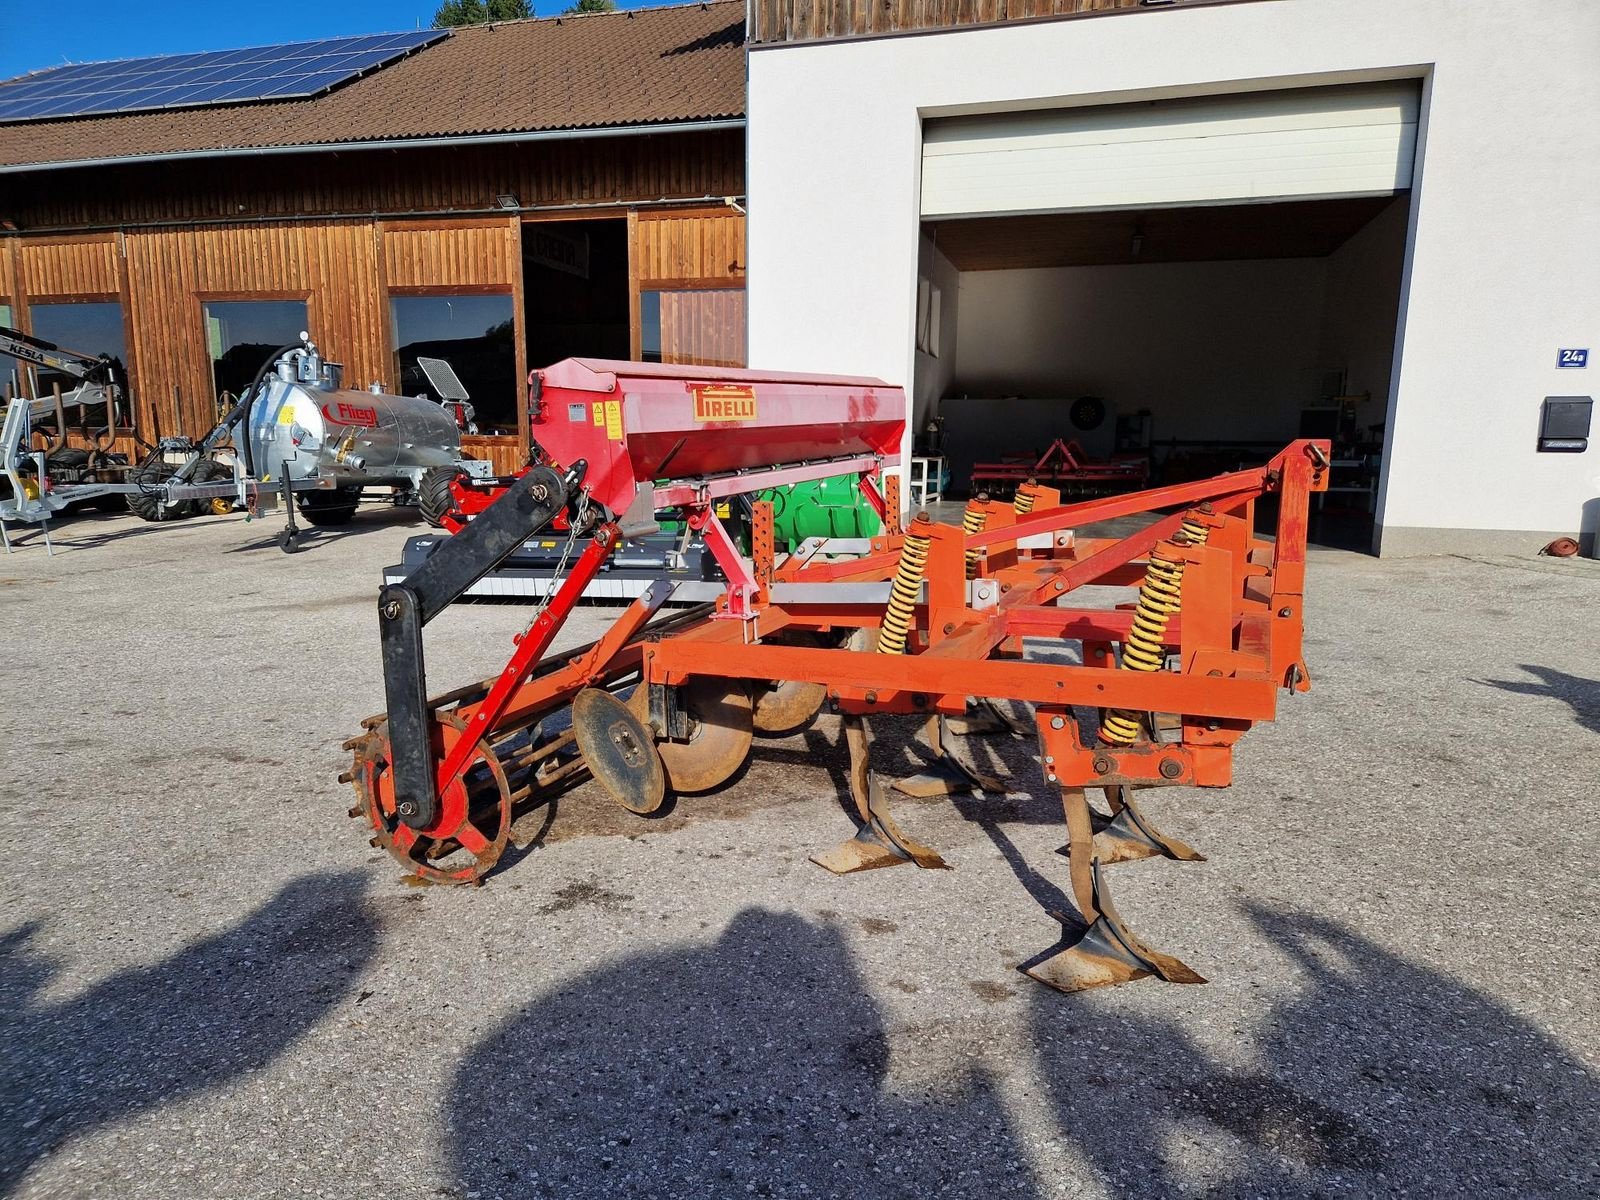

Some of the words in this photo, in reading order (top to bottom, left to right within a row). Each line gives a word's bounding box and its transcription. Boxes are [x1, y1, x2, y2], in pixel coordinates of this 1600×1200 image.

[10, 343, 44, 361] KESLA
[696, 384, 754, 417] PIRELLI
[337, 403, 377, 424] Fliegl
